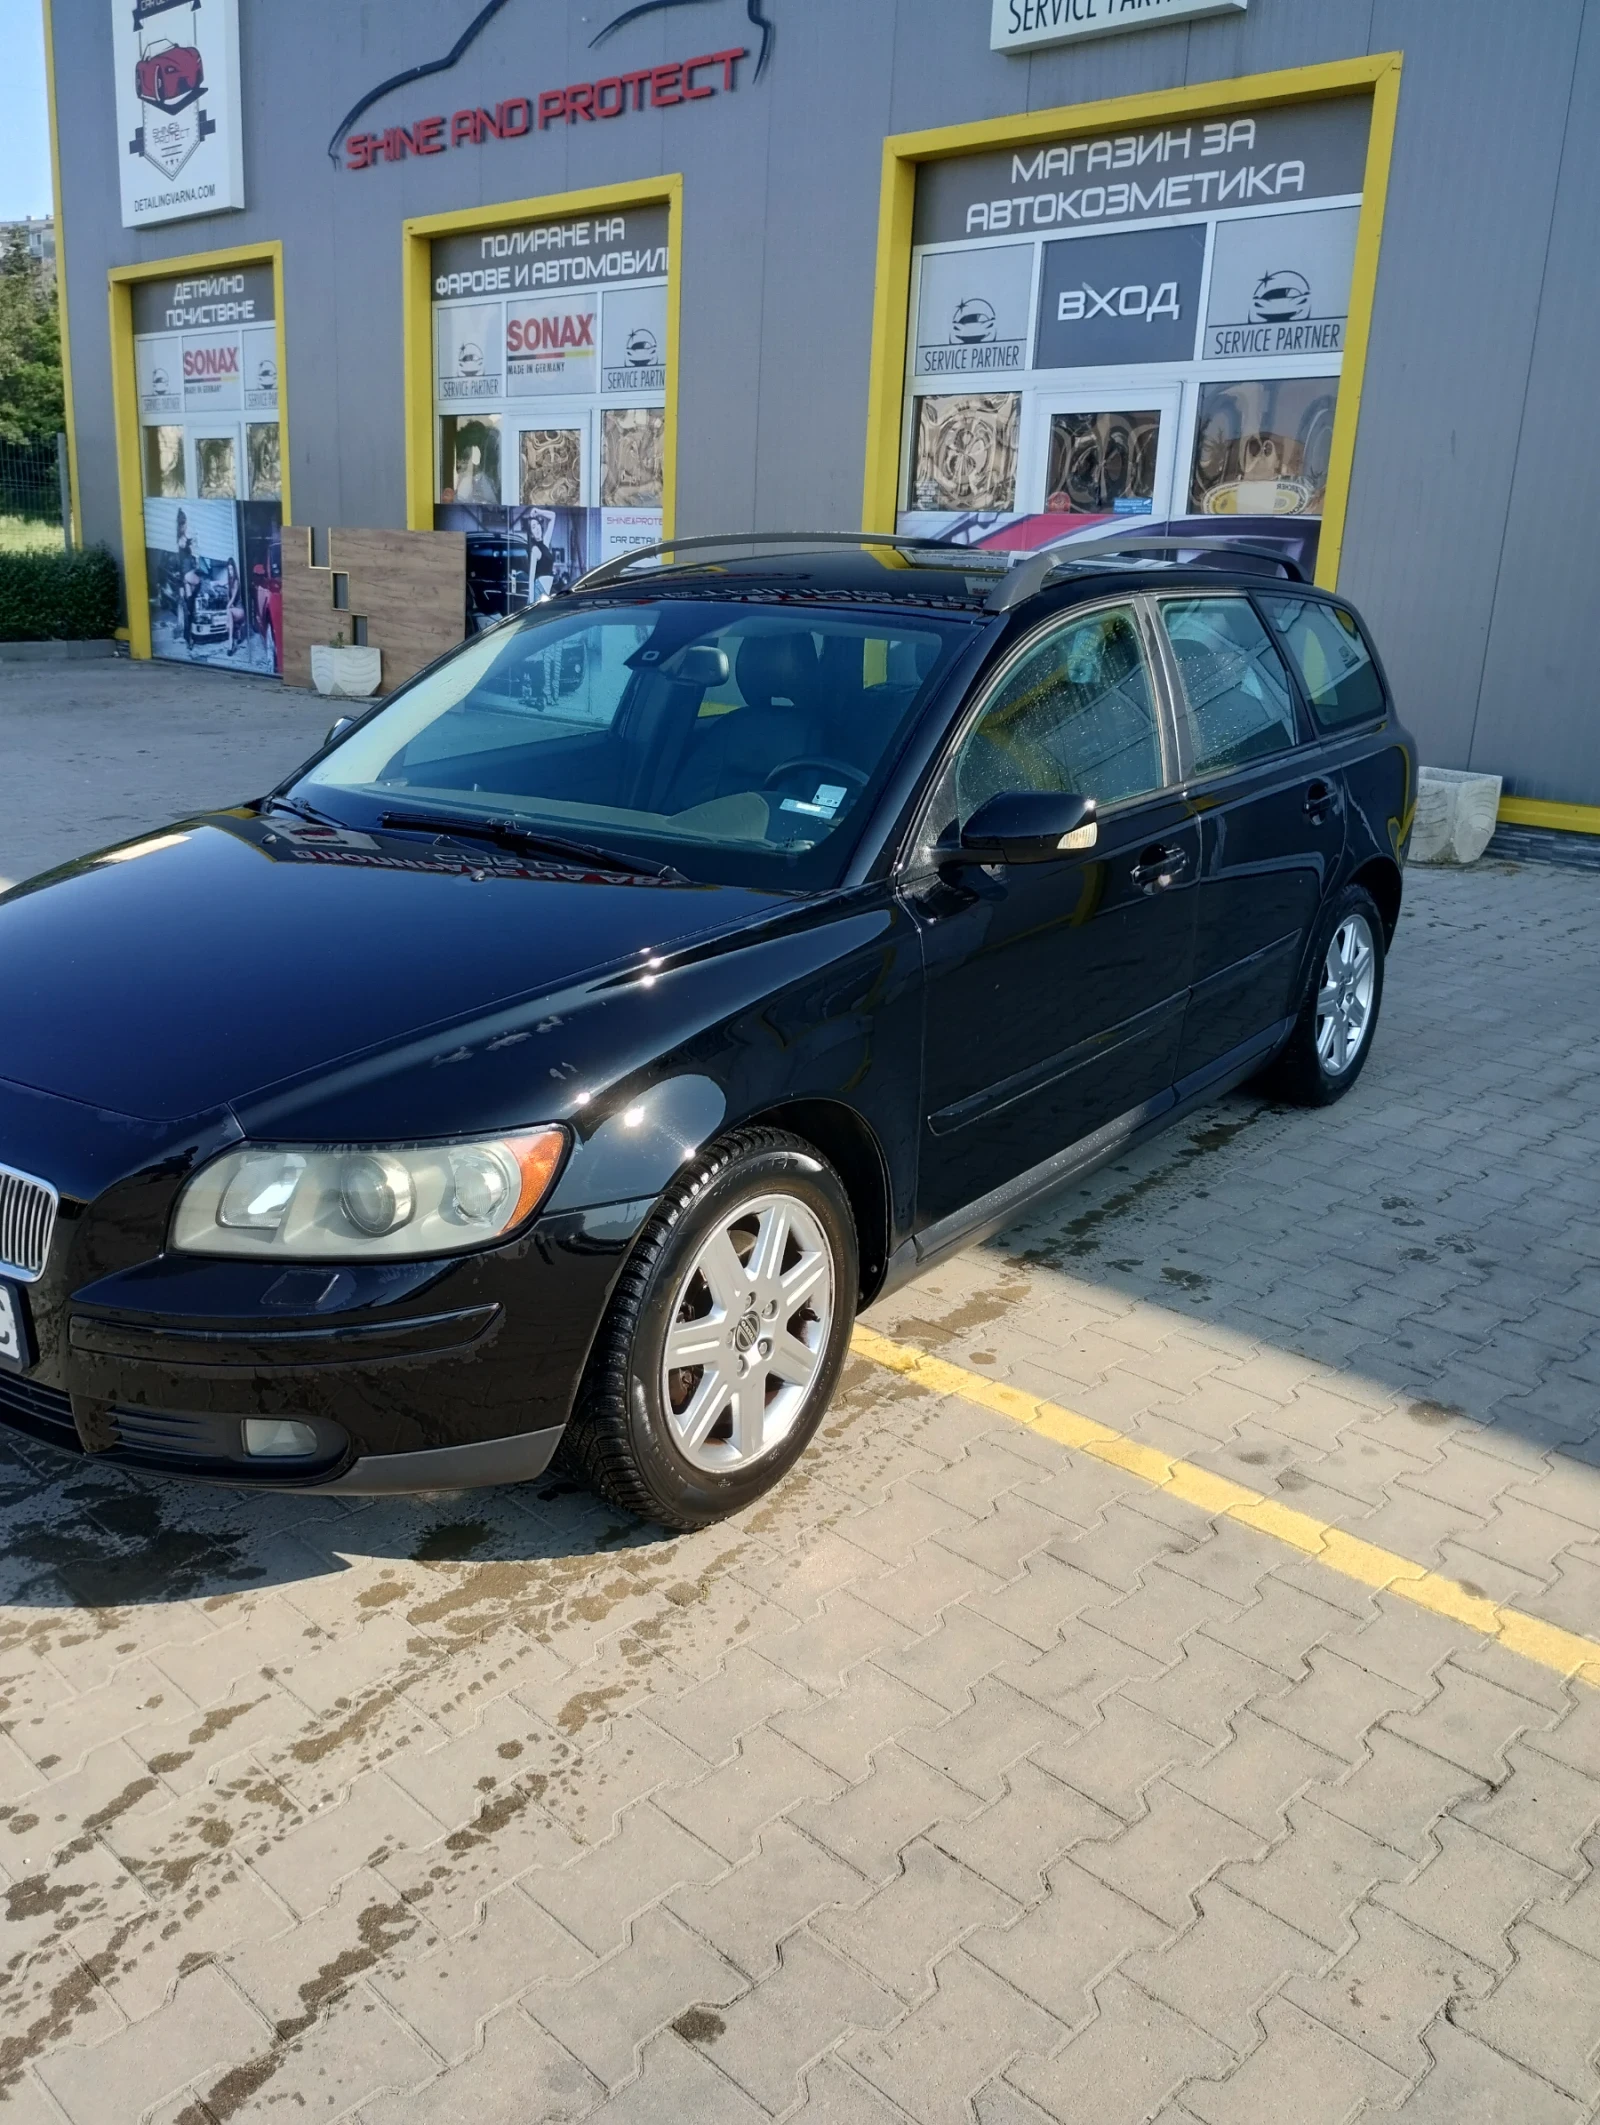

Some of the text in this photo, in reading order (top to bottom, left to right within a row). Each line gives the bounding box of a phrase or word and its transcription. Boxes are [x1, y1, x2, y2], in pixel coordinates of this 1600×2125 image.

[347, 46, 745, 170] SHINE AND PROTECT
[1011, 119, 1256, 184] МАГАЗИН ЗА
[134, 184, 216, 212] DETAILINGVARNA.COM
[966, 160, 1306, 233] АВТОКОЗМЕТИКА
[481, 217, 625, 259] ПОЛИРАНЕ НА
[173, 274, 244, 306] ДЕТАЙЛНО
[435, 266, 511, 296] ФАРОВЕ
[514, 264, 529, 287] И
[165, 299, 255, 327] ПОЧИСТВАНЕ
[1057, 281, 1181, 322] ВХОД
[507, 313, 593, 352] SONAX
[1214, 323, 1341, 356] SERVICE PARTNER
[184, 347, 239, 376] SONAX
[507, 361, 566, 375] MADE IN GERMANY
[924, 346, 1020, 372] SERVICE PARTNER
[443, 378, 499, 398] SERVICE PARTNER
[607, 371, 638, 390] SERVICE
[609, 536, 628, 544] CAR
